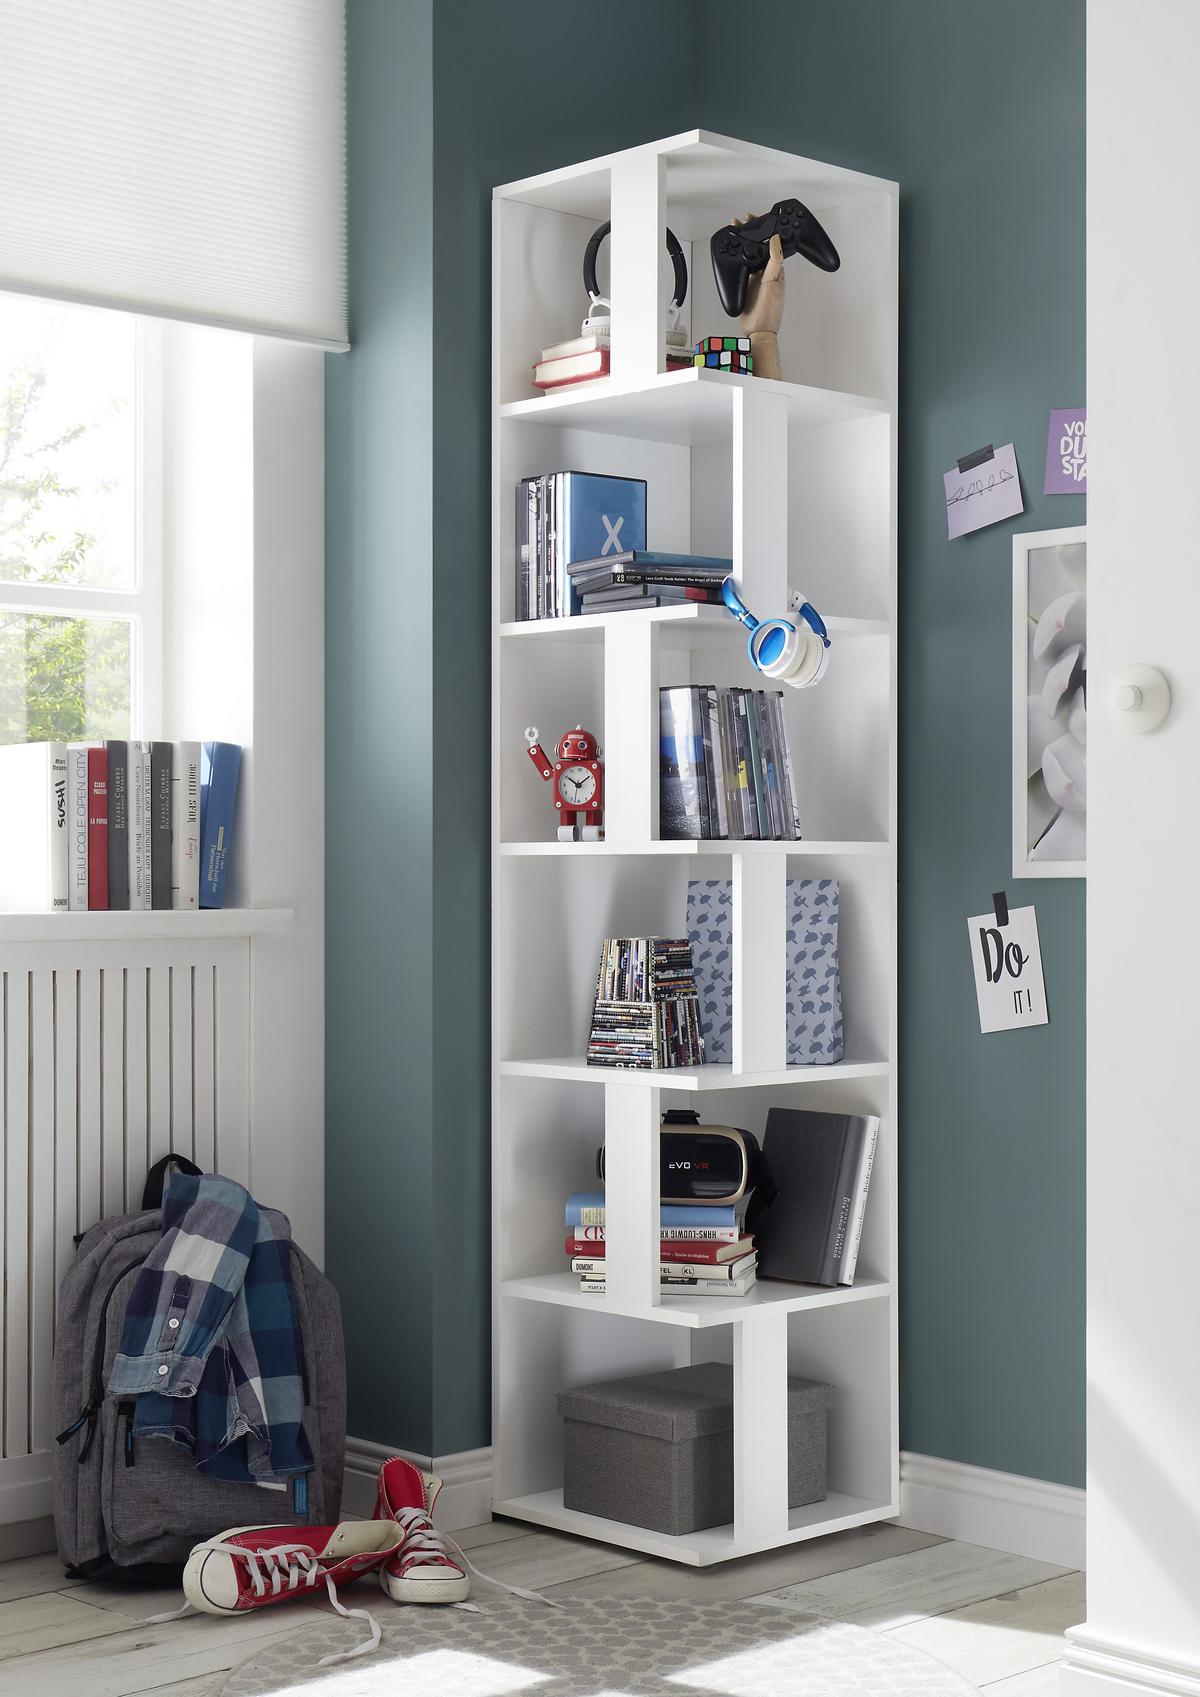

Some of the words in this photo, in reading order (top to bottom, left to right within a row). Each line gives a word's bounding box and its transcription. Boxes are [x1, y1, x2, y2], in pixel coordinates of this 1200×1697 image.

[1063, 421, 1086, 437] VO
[601, 515, 625, 555] X
[76, 751, 87, 779] CITY
[54, 780, 66, 829] SUSHI
[77, 781, 87, 817] OPEN
[77, 820, 87, 854] COLE
[77, 857, 87, 889] TEJU
[136, 855, 141, 864] an
[979, 927, 1030, 984] Do
[668, 1161, 691, 1170] EVO
[575, 1263, 594, 1271] DUMONT
